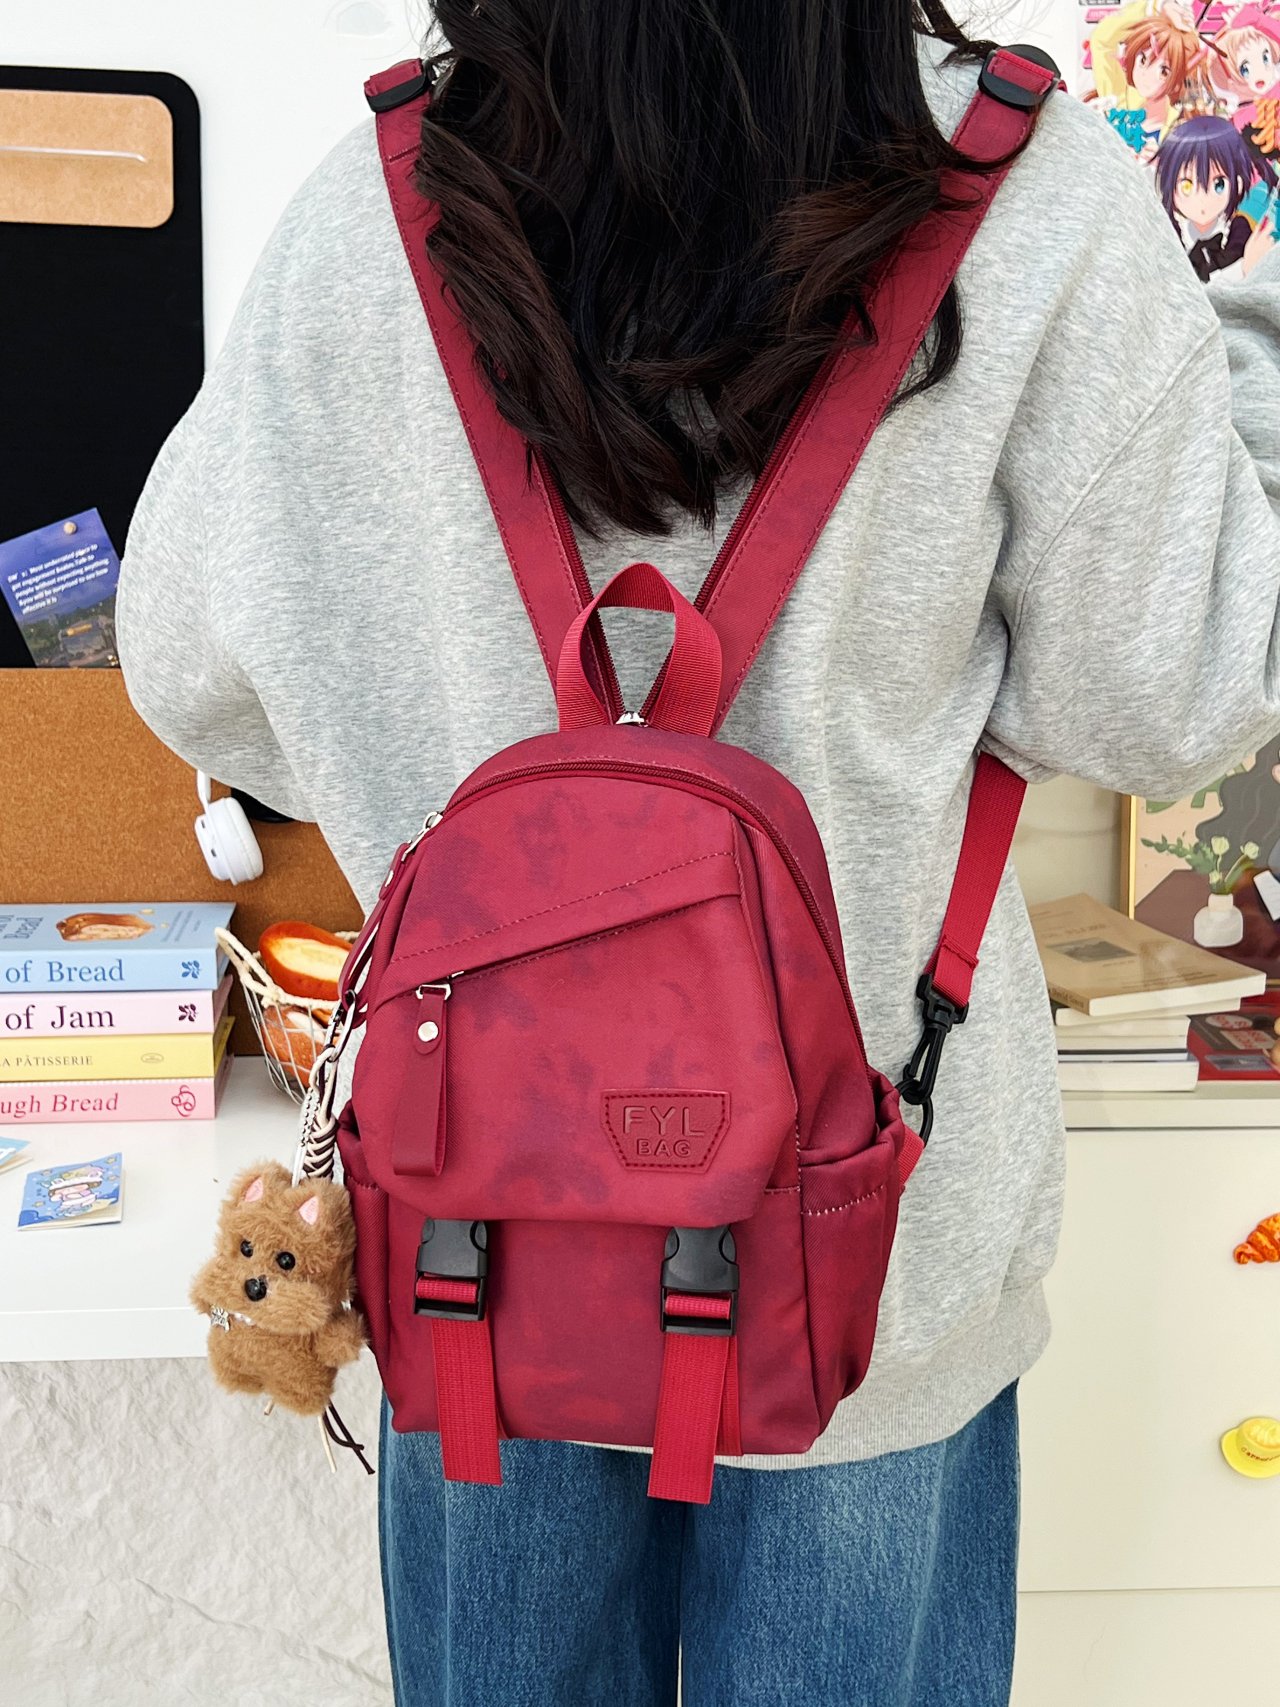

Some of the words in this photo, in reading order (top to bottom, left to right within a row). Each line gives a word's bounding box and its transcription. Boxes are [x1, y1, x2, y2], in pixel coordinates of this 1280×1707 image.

[5, 959, 33, 984] of
[46, 958, 125, 983] Bread
[5, 1004, 36, 1031] of
[50, 1005, 115, 1030] Jam
[16, 1054, 94, 1067] PÂTISSERIE
[52, 1092, 119, 1113] Bread
[623, 1105, 706, 1137] FYL
[636, 1138, 692, 1158] BAG
